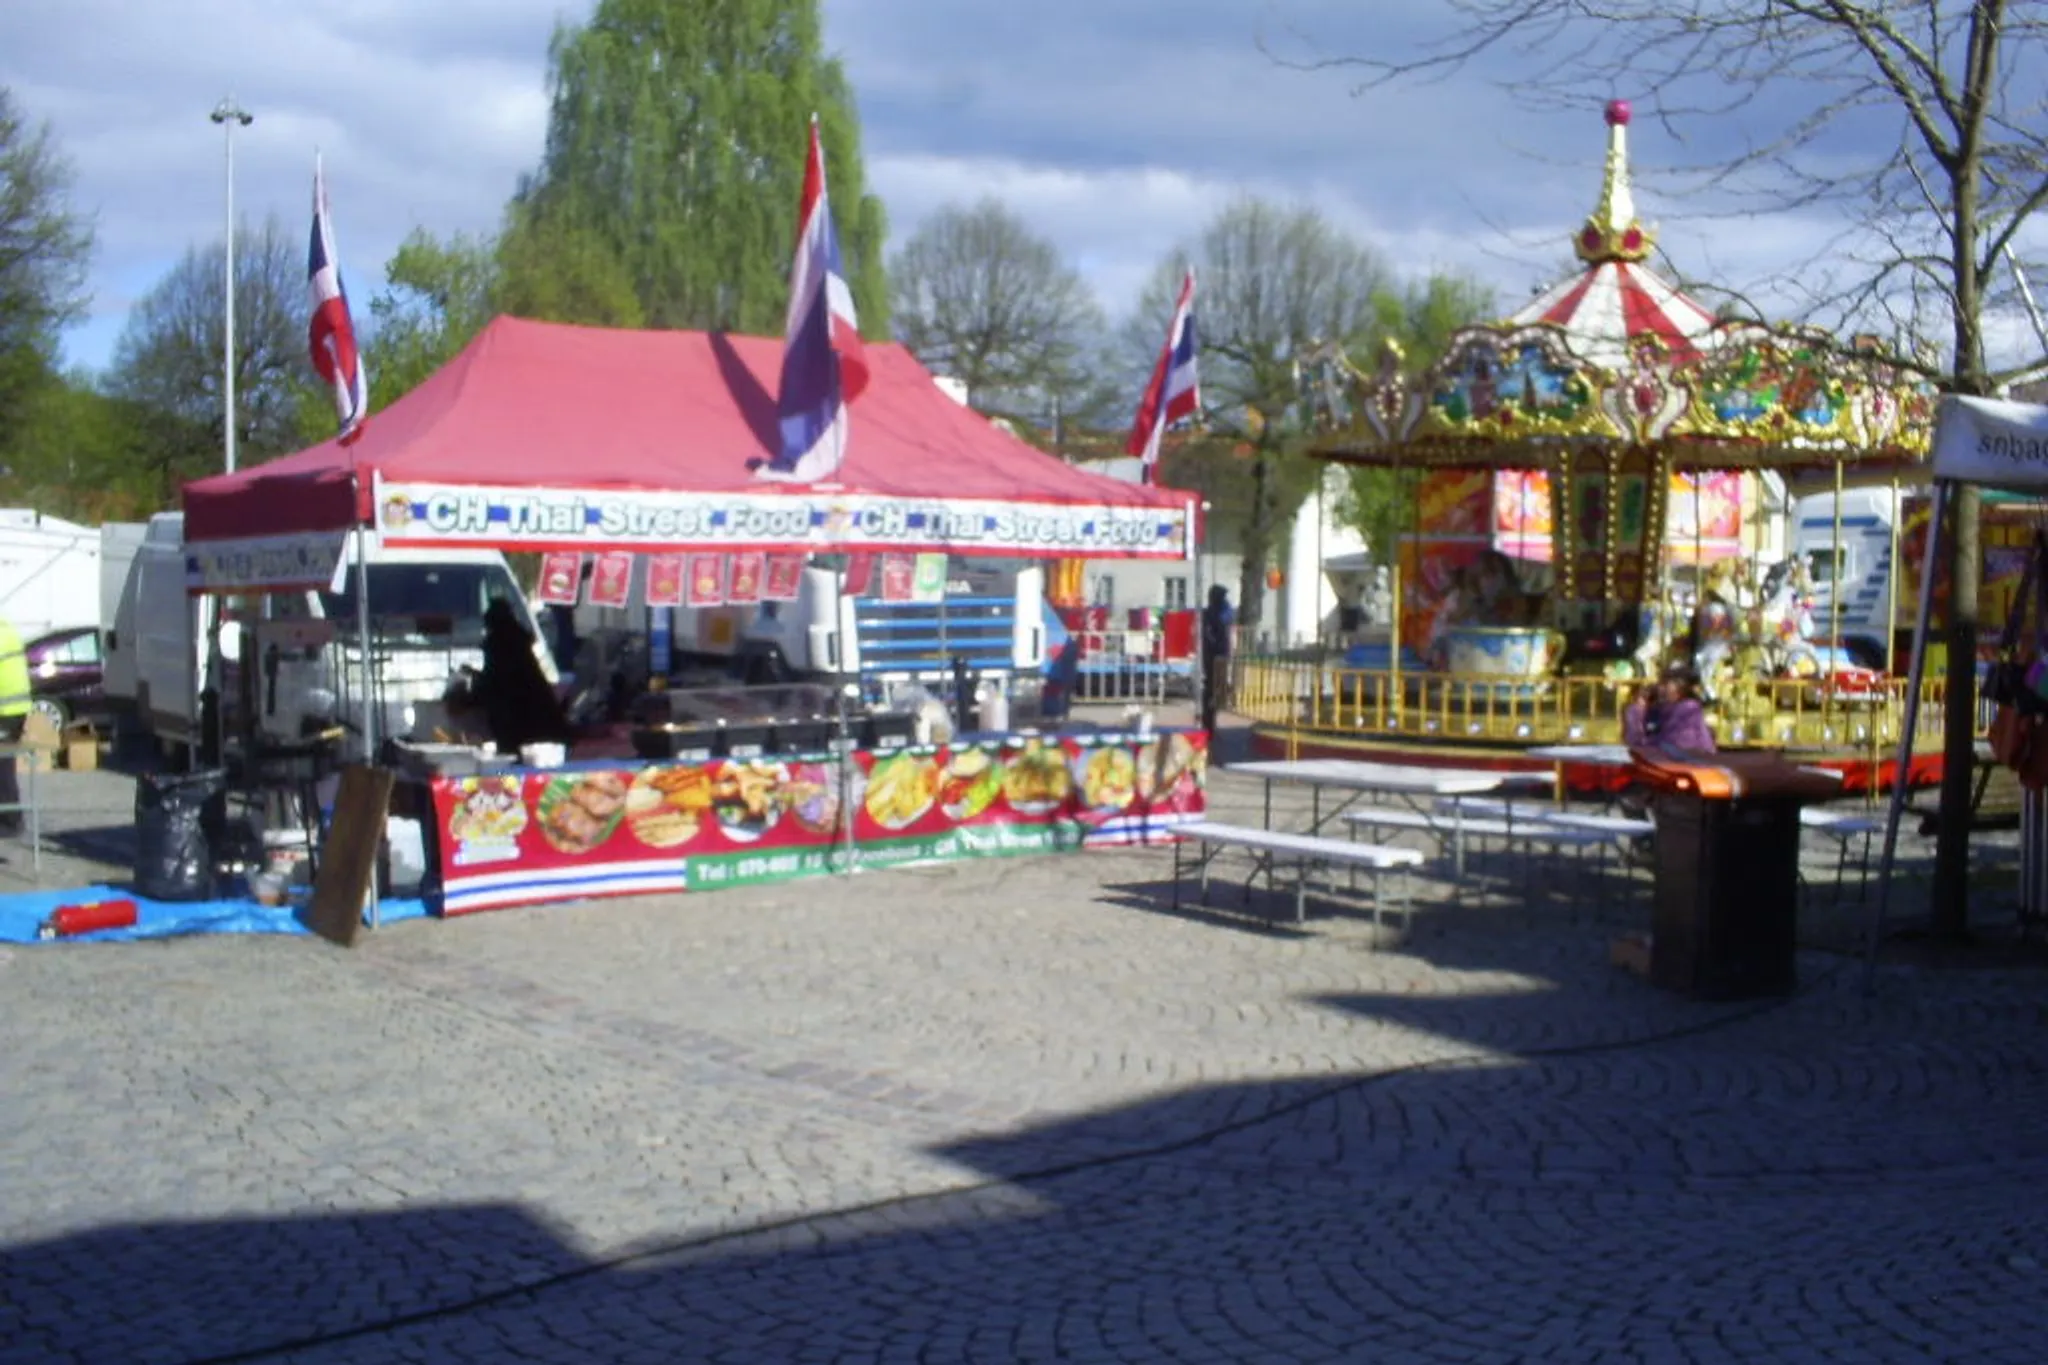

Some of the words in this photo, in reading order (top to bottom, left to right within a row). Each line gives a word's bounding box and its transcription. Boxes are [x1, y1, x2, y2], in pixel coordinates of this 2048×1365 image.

[427, 494, 488, 532] CH
[502, 496, 586, 534] Thai
[600, 498, 715, 536] Street
[724, 502, 814, 537] Food
[860, 501, 907, 537] CH
[919, 504, 984, 540] Thai
[995, 508, 1085, 544] Street
[1092, 511, 1158, 545] Food
